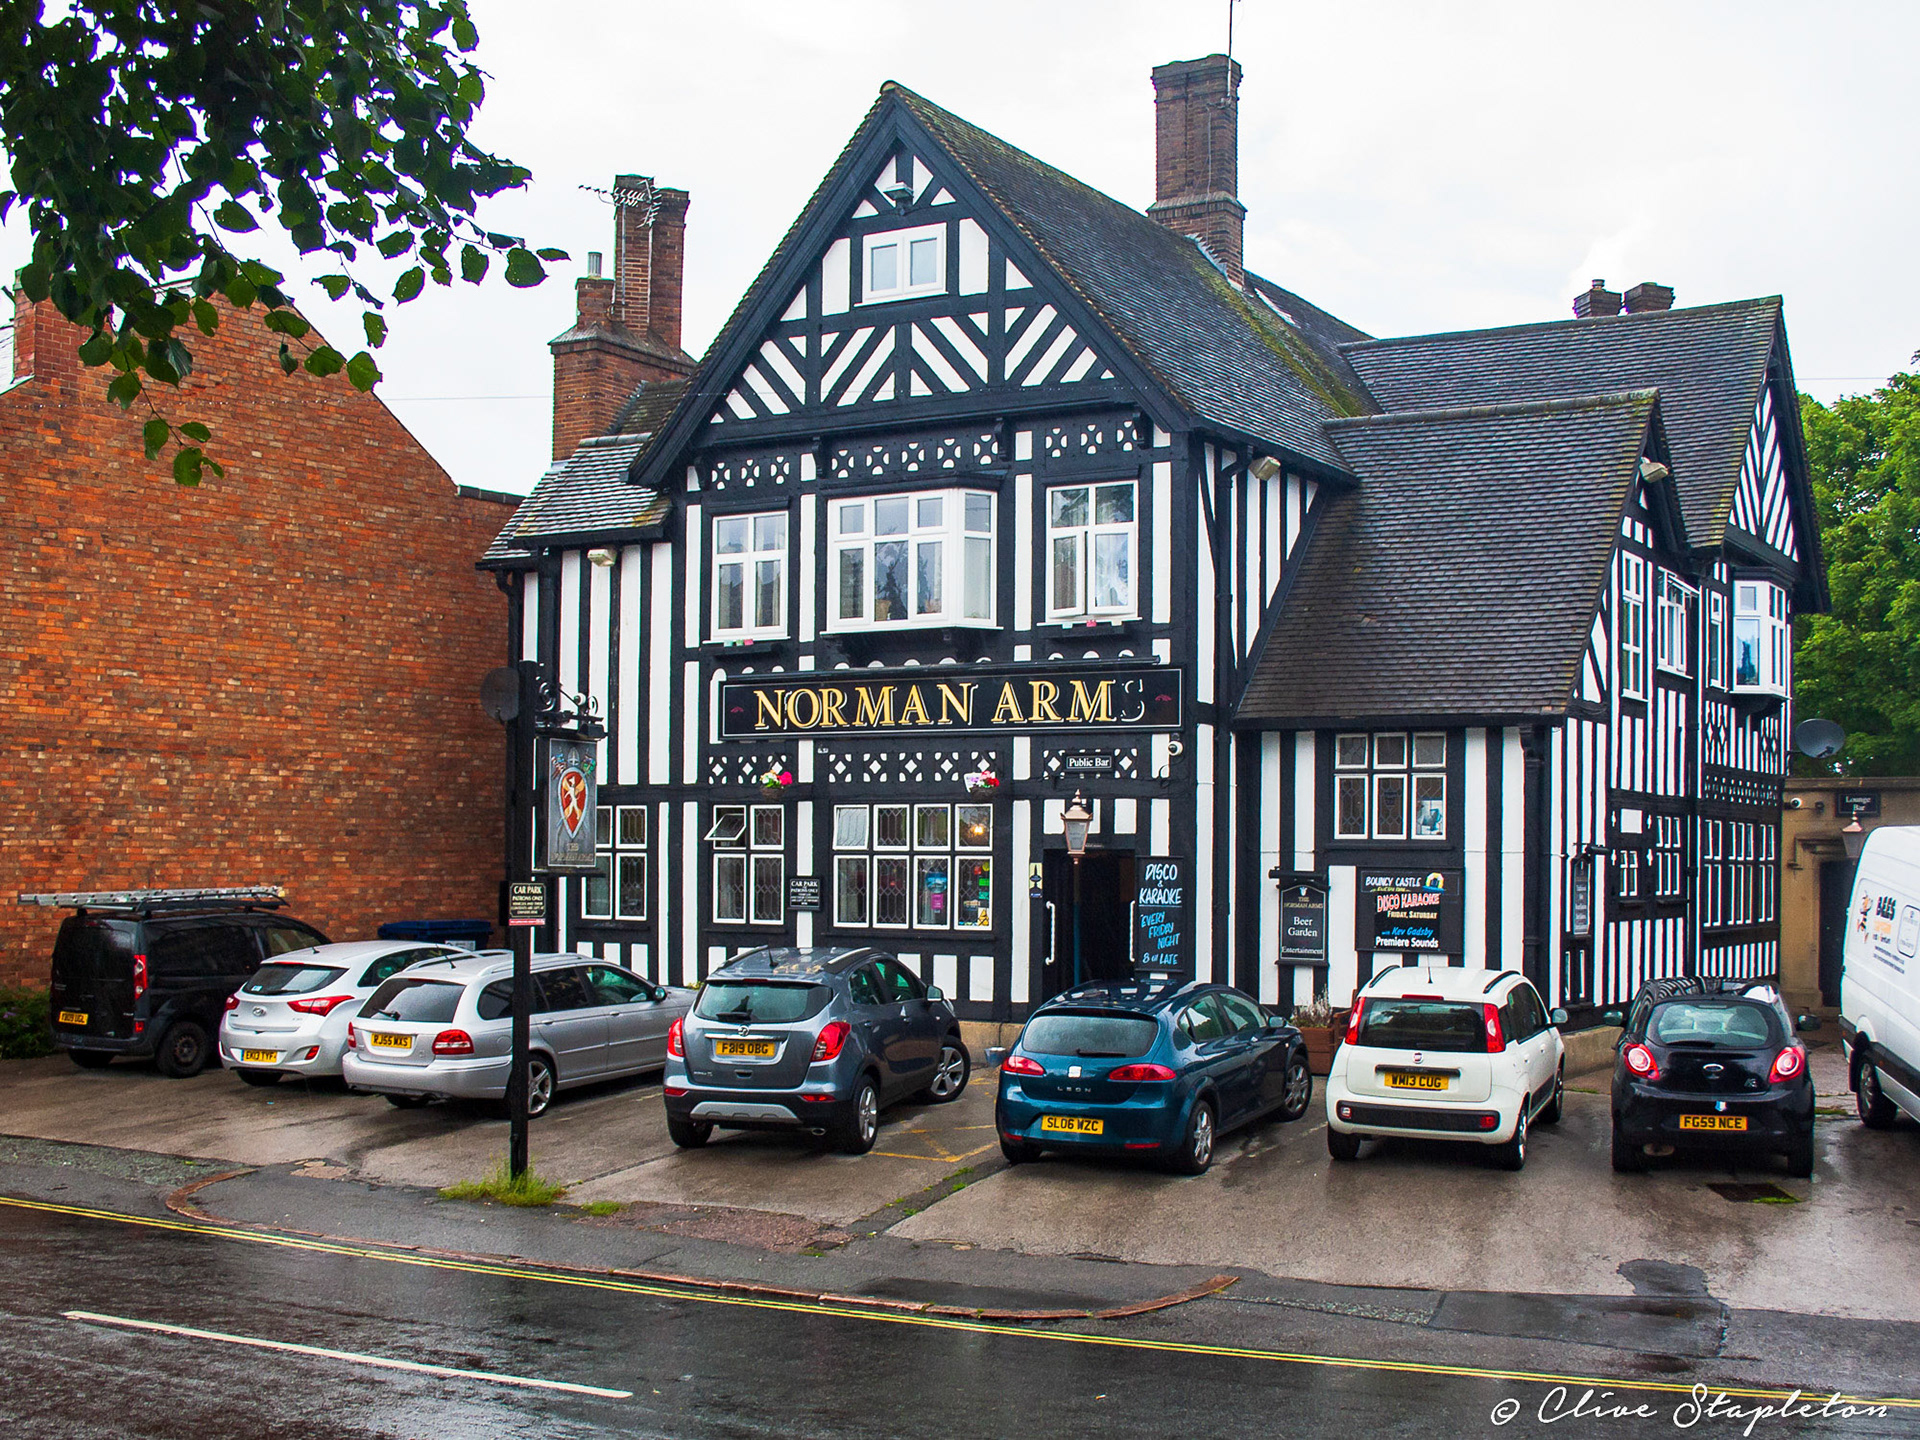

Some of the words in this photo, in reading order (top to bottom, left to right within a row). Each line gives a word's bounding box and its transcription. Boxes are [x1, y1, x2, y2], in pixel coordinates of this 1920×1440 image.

[753, 682, 979, 730] NORMAN
[1069, 757, 1094, 767] Public
[1095, 757, 1110, 767] Bar
[1145, 864, 1178, 880] DISCO
[1157, 880, 1164, 888] &
[1365, 876, 1394, 887] BOUNCY
[1395, 876, 1422, 888] CASTLE
[513, 886, 526, 894] CAR
[527, 886, 542, 894] PARK
[1139, 888, 1183, 905] KARAOKE
[1376, 893, 1400, 912] DISCO
[1401, 893, 1441, 908] KARAOKE
[1141, 911, 1165, 928] EVERY
[1293, 916, 1313, 926] Beer
[1148, 922, 1174, 939] FRIDAY
[1287, 927, 1318, 938] Garden
[1391, 926, 1406, 935] Kev
[1406, 926, 1434, 938] Gadsby
[1157, 933, 1180, 950] NIGHT
[1375, 936, 1410, 947] Premiere
[1411, 937, 1439, 948] Sounds
[1281, 945, 1324, 955] Entertainment
[1142, 952, 1150, 963] 8
[1159, 953, 1178, 965] LATE
[373, 1034, 392, 1046] RJ55
[722, 1043, 745, 1053] FB19
[747, 1043, 769, 1054] OBG
[1418, 1076, 1442, 1088] CUG
[1047, 1117, 1075, 1129] SL06
[1684, 1116, 1715, 1128] FG59
[1718, 1117, 1743, 1129] NCE
